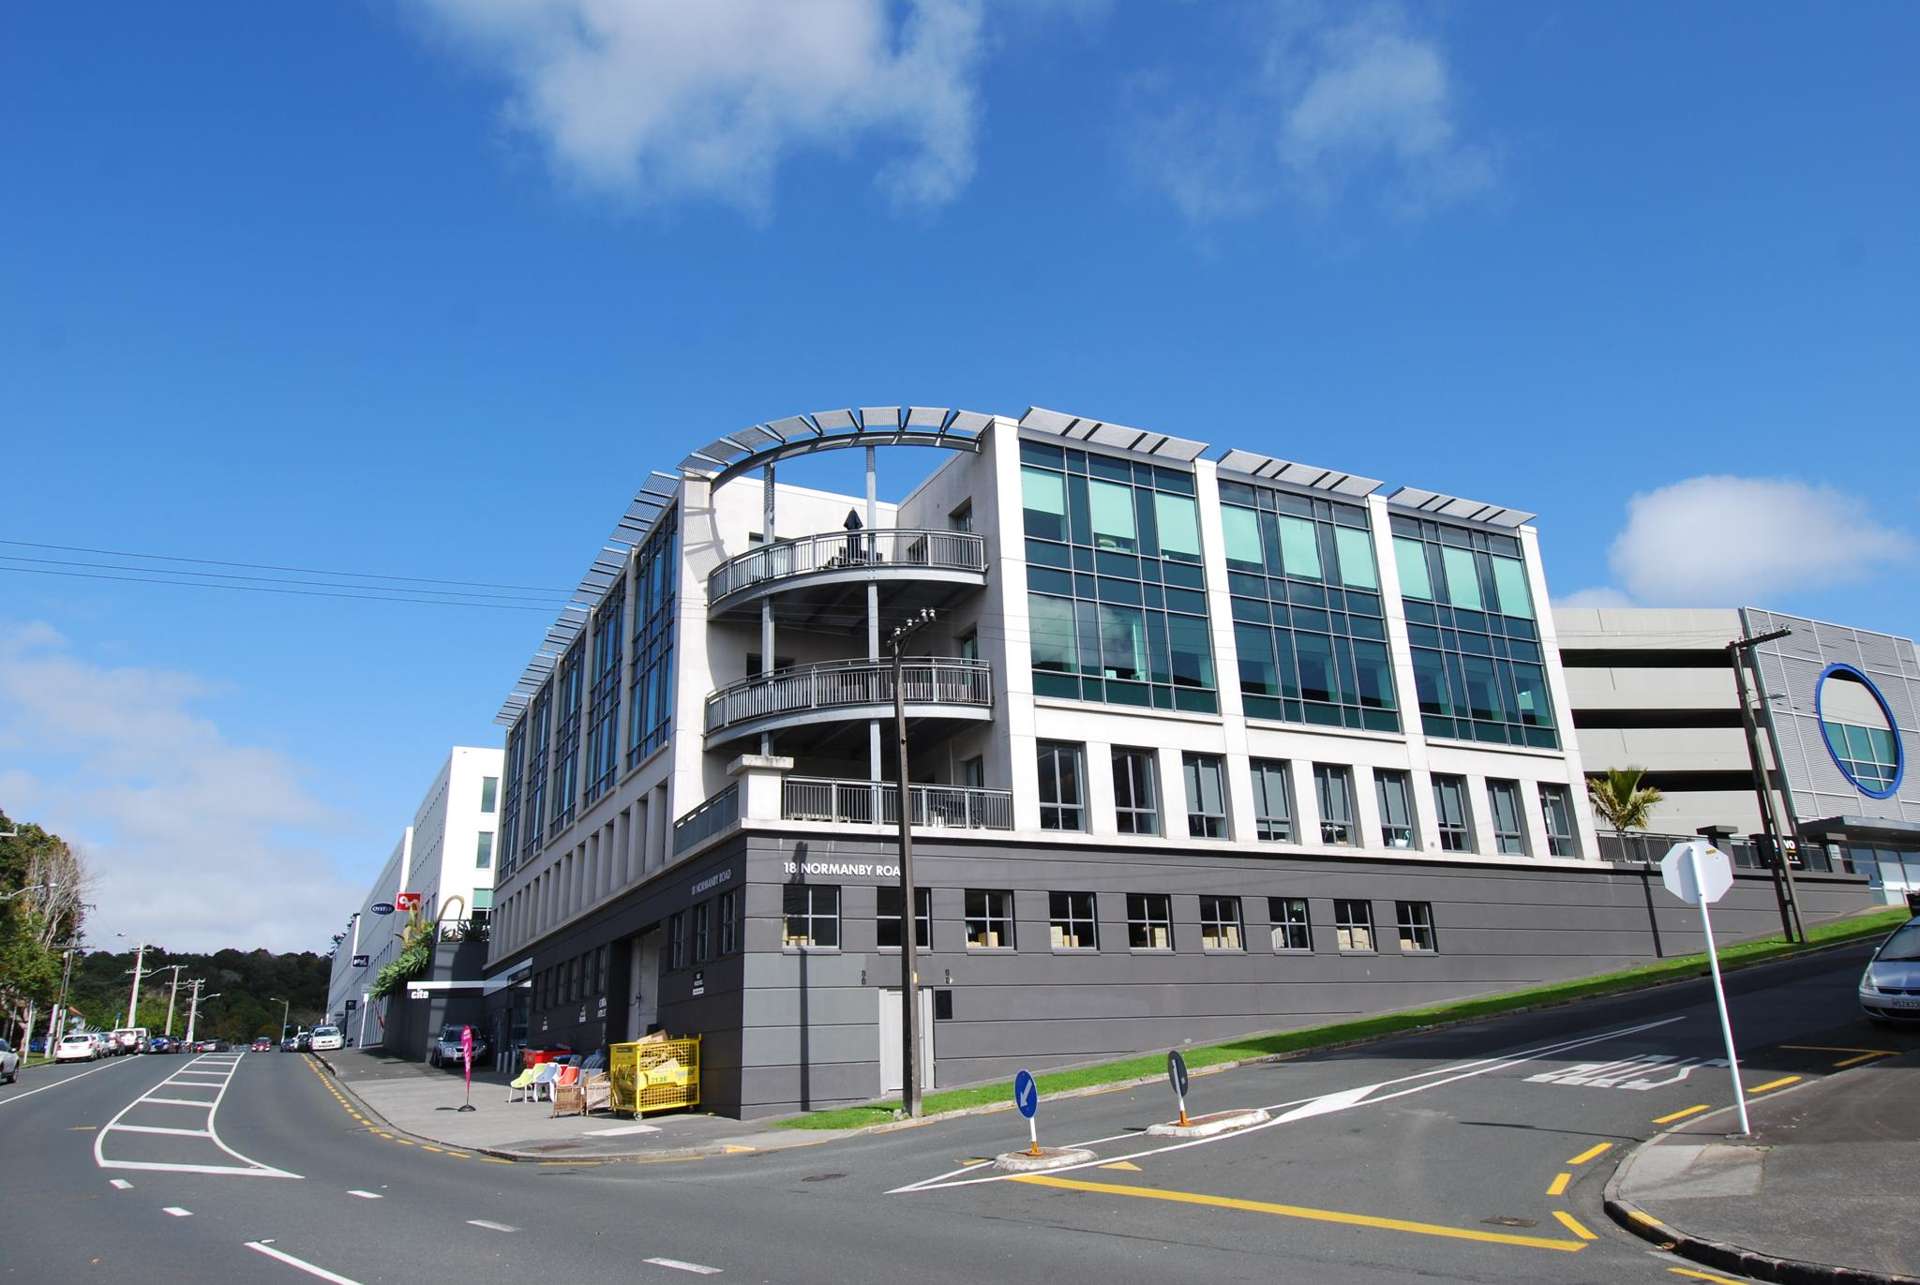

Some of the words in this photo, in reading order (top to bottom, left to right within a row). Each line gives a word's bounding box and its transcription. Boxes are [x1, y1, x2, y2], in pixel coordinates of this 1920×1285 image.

[784, 862, 797, 874] 18
[801, 862, 873, 876] NORMANBY
[876, 865, 901, 877] ROA
